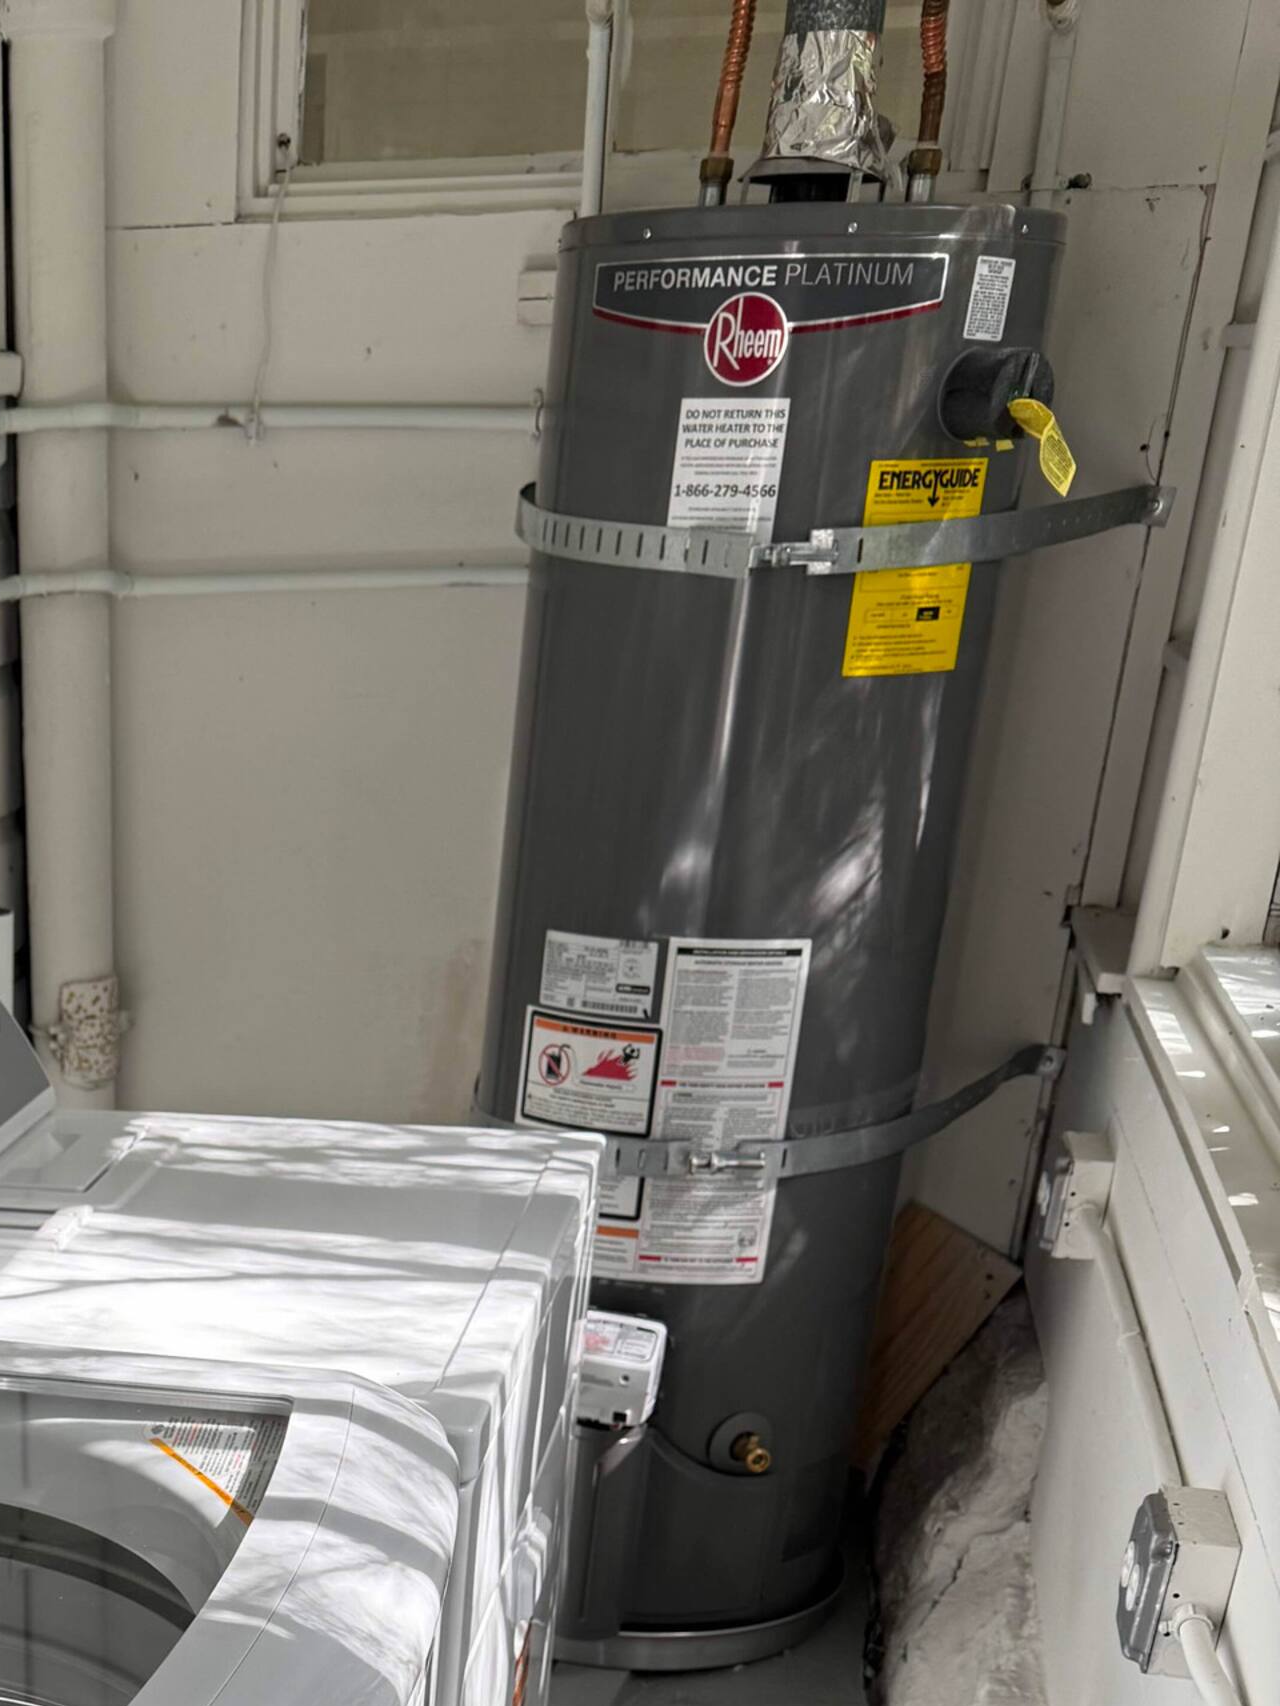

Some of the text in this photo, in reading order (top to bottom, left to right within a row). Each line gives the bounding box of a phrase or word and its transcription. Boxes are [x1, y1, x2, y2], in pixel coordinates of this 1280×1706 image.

[613, 262, 915, 292] PERFORMANCE PLATINUM
[713, 297, 782, 370] Rheem
[685, 409, 786, 419] DO NOT RETURN THIS
[682, 423, 785, 433] WATER HEATER TO THE
[684, 438, 779, 448] PLACE OF PURCHASE
[674, 484, 776, 498] 1-866-279-4566
